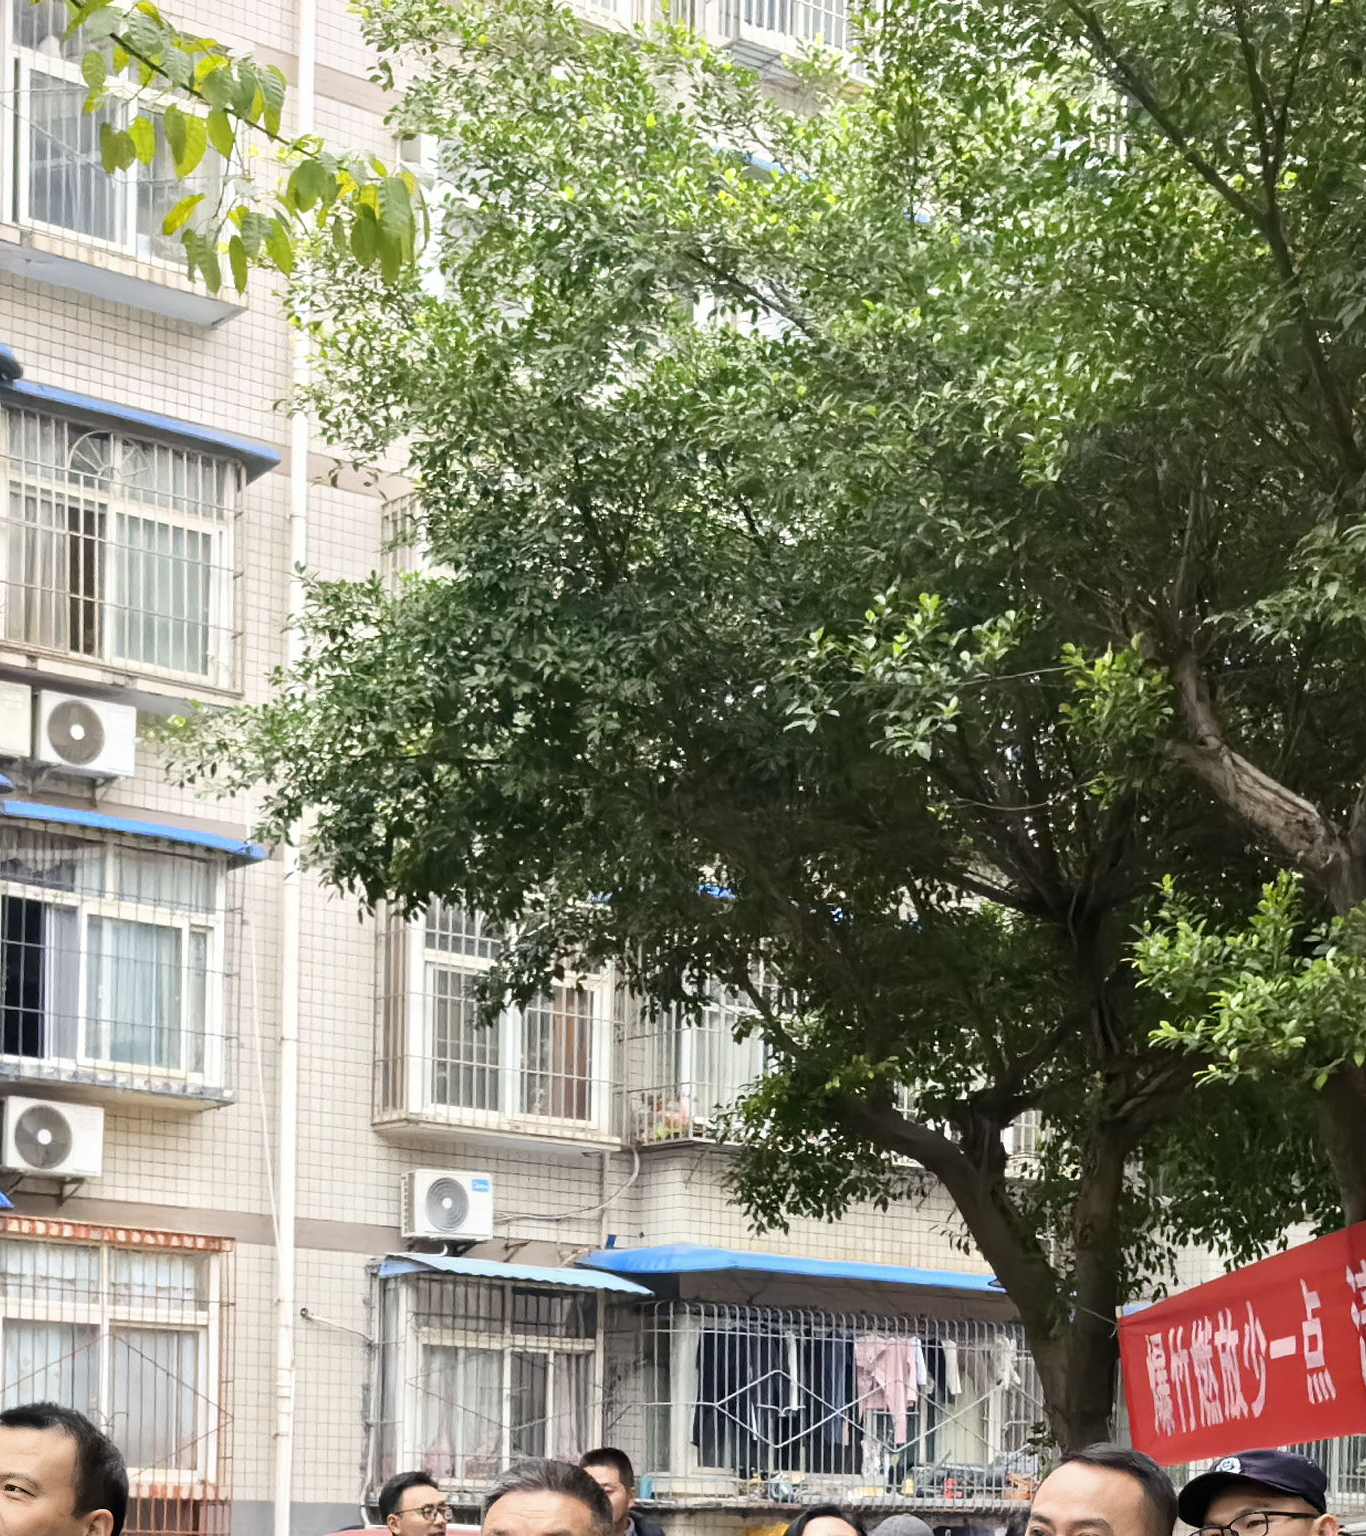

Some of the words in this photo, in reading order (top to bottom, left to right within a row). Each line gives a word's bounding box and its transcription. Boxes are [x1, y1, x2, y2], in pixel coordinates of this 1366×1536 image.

[1145, 1278, 1336, 1436] 爆竹燃放少一点
